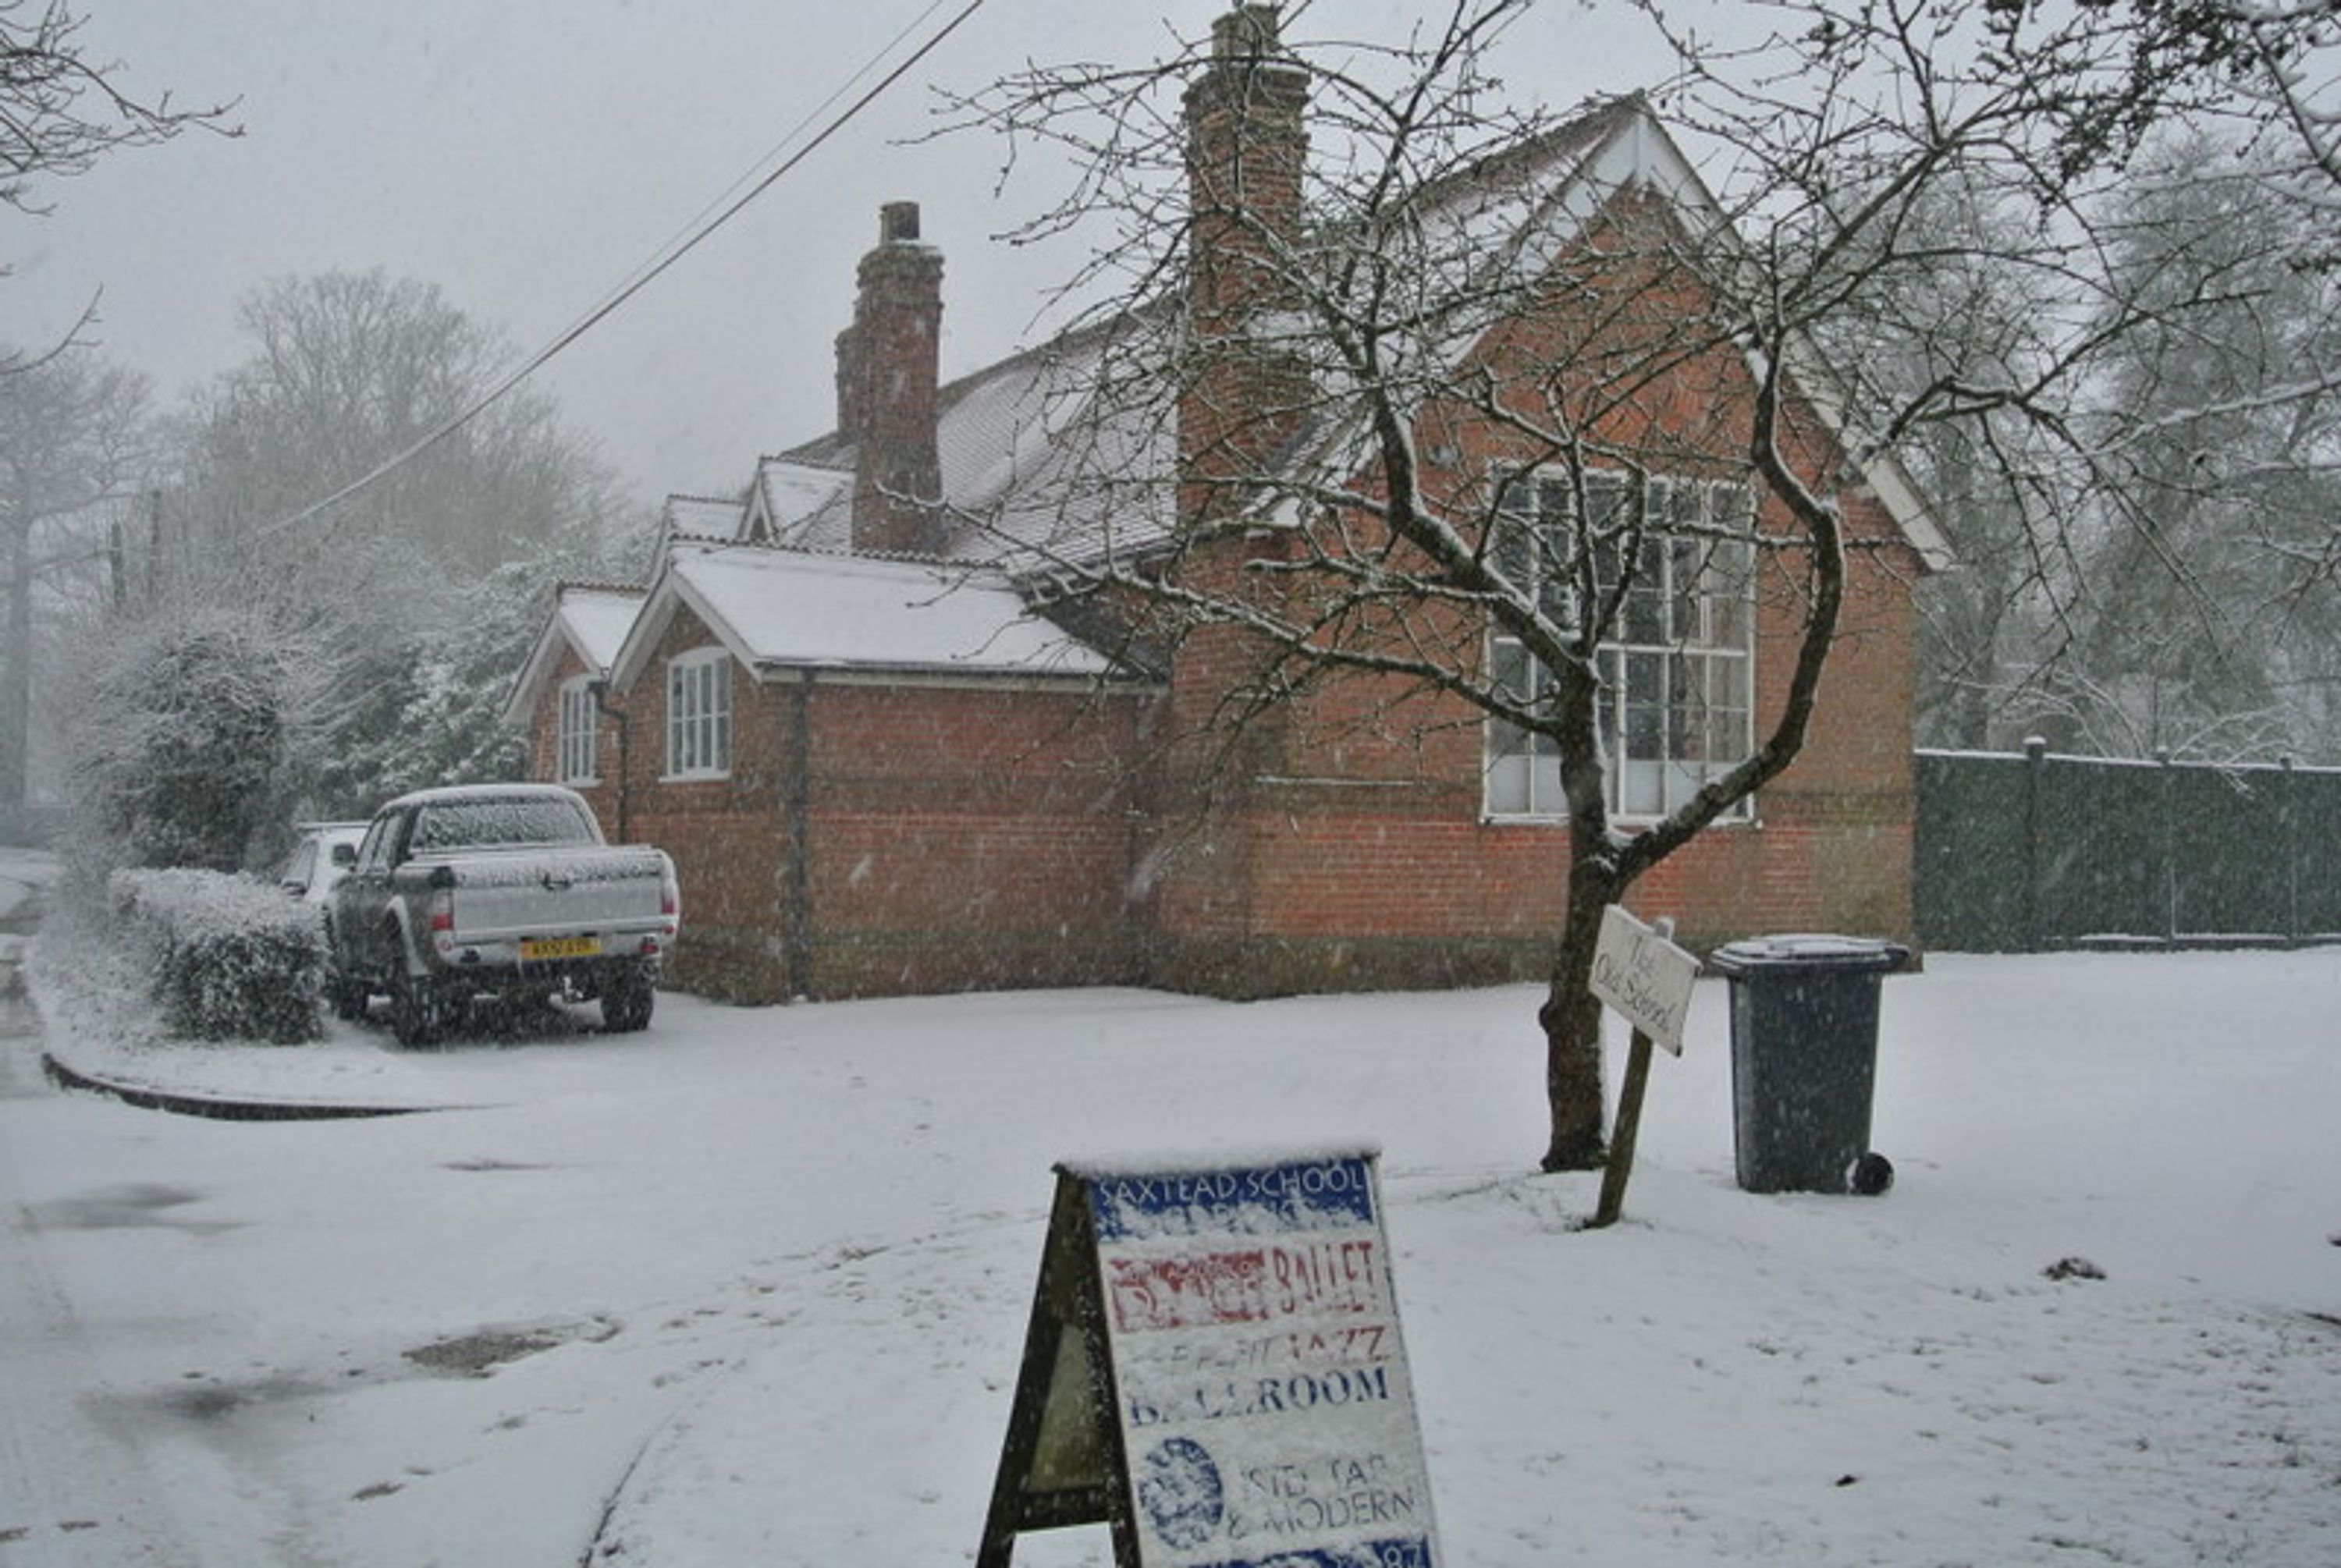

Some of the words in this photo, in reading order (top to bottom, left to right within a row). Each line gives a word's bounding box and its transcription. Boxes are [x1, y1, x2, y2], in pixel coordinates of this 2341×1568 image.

[1099, 1175, 1238, 1207] SAXTEAD
[1245, 1165, 1365, 1197] SCHOOL
[1263, 1485, 1416, 1535] MODERN
